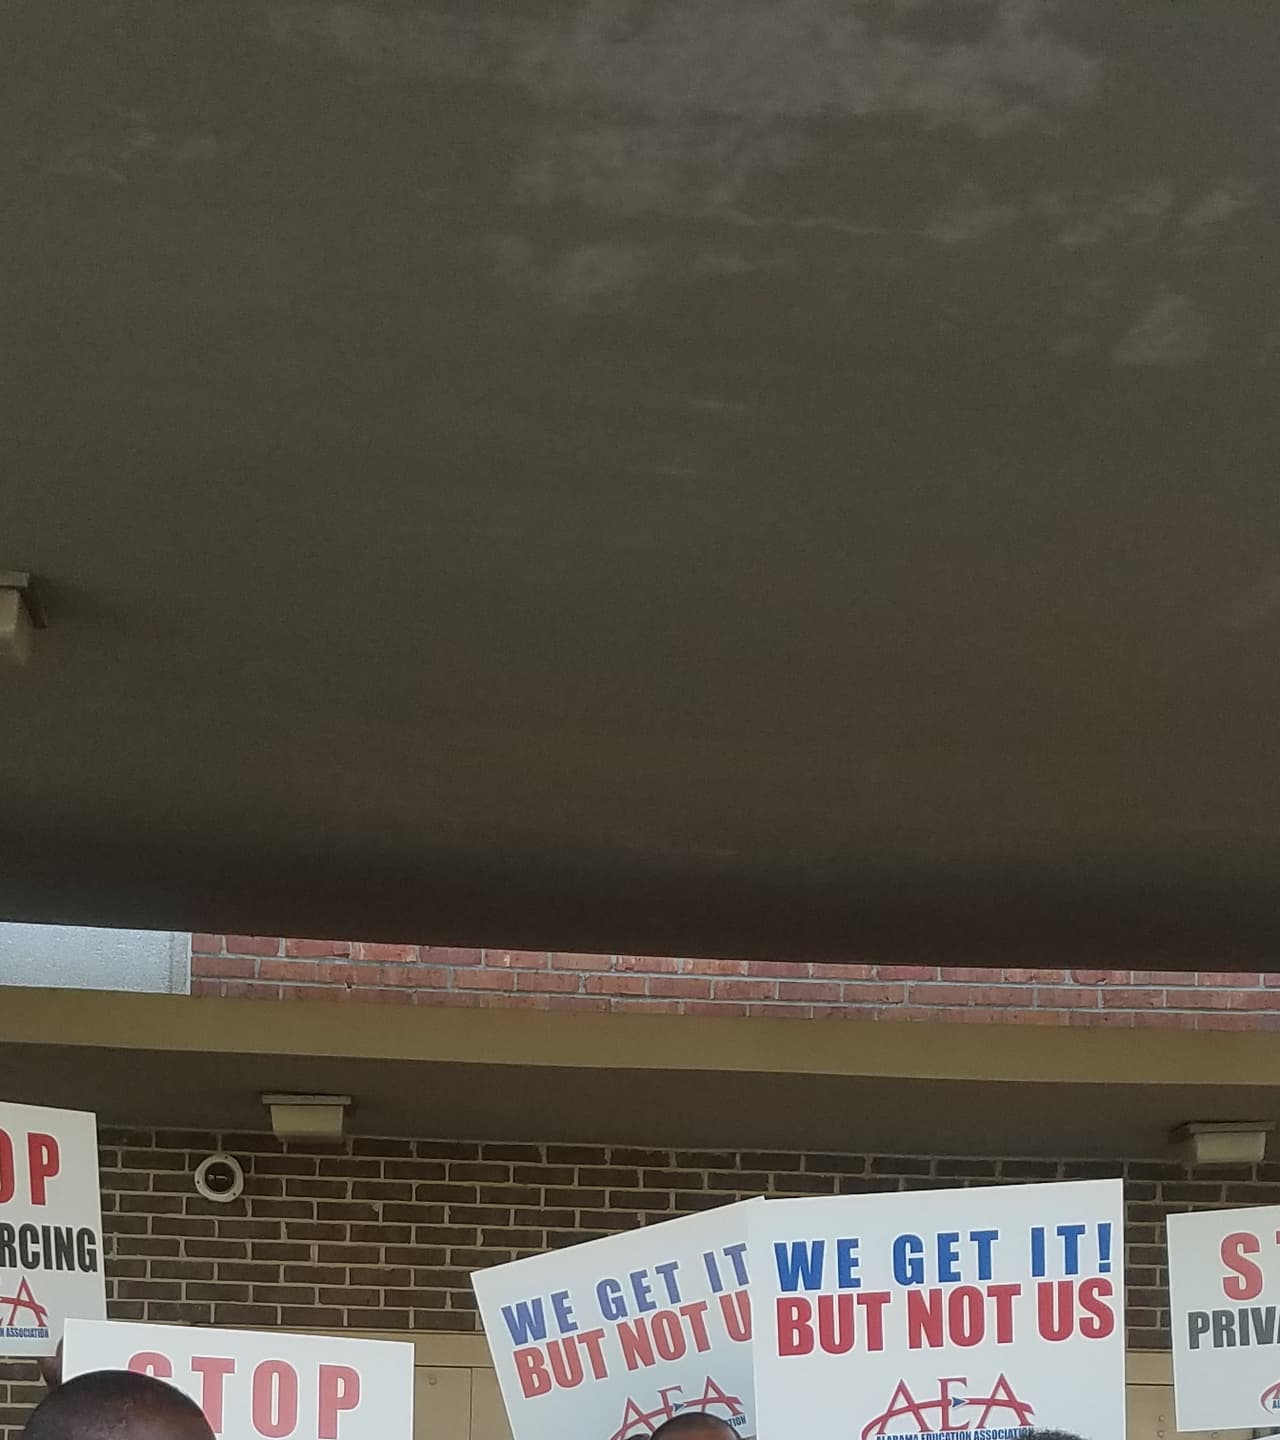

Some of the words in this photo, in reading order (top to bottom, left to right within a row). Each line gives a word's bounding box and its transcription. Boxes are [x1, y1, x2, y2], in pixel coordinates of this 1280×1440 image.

[500, 1290, 579, 1346] WE
[595, 1261, 682, 1321] GET
[703, 1242, 751, 1294] IT
[773, 1237, 862, 1293] WE
[892, 1229, 999, 1287] GET
[1030, 1222, 1113, 1278] IT!
[6, 1326, 49, 1339] ASSOCIATION
[512, 1327, 609, 1399] BUT
[616, 1300, 711, 1372] NOT
[718, 1289, 753, 1342] U
[776, 1291, 892, 1357] BUT
[906, 1283, 1022, 1350] NOT
[1037, 1276, 1115, 1342] US
[867, 1373, 1035, 1436] AEA
